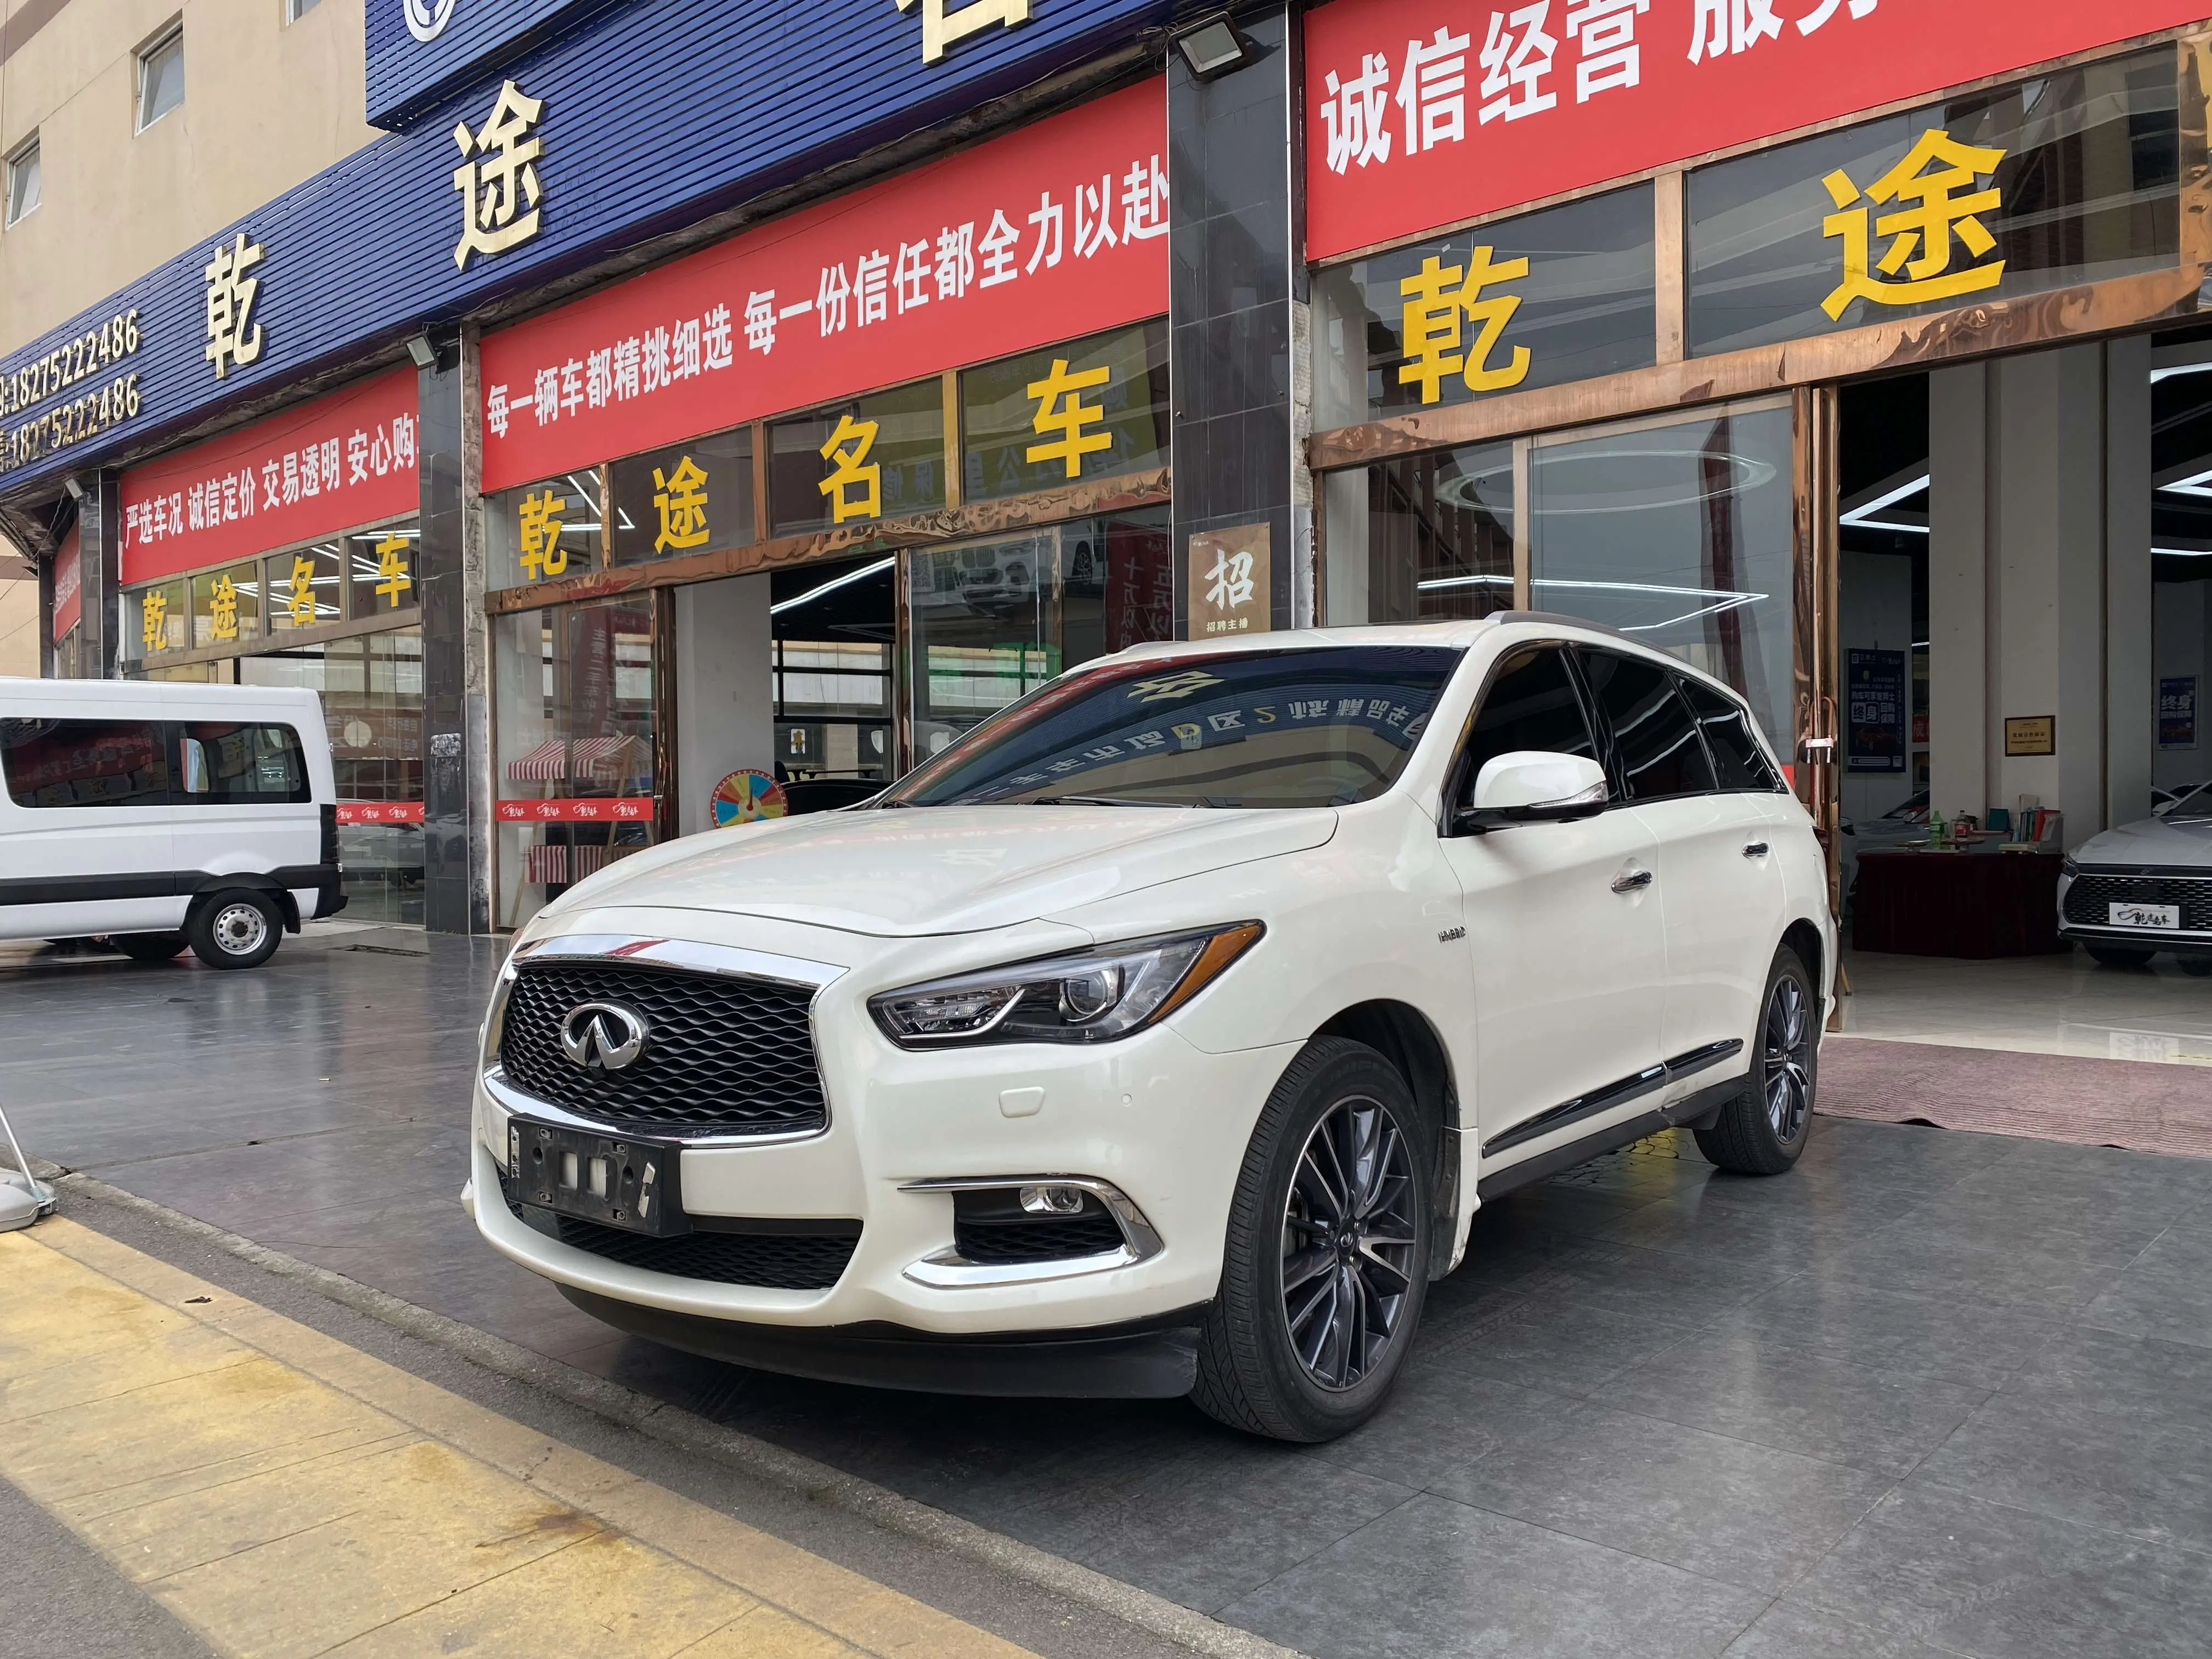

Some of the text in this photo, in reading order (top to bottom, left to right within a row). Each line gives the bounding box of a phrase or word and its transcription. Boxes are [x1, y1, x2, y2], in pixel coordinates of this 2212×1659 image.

[1321, 0, 1650, 176] 诚信经营
[487, 154, 1170, 439] 每一辆车都精挑细选 每一份信任都全力以赴
[125, 412, 420, 549] 严选车况 诚信定价 交易透明 安心购
[1205, 548, 1255, 611] 招
[1206, 617, 1249, 632] 招聘主播
[2161, 694, 2193, 710] 终身
